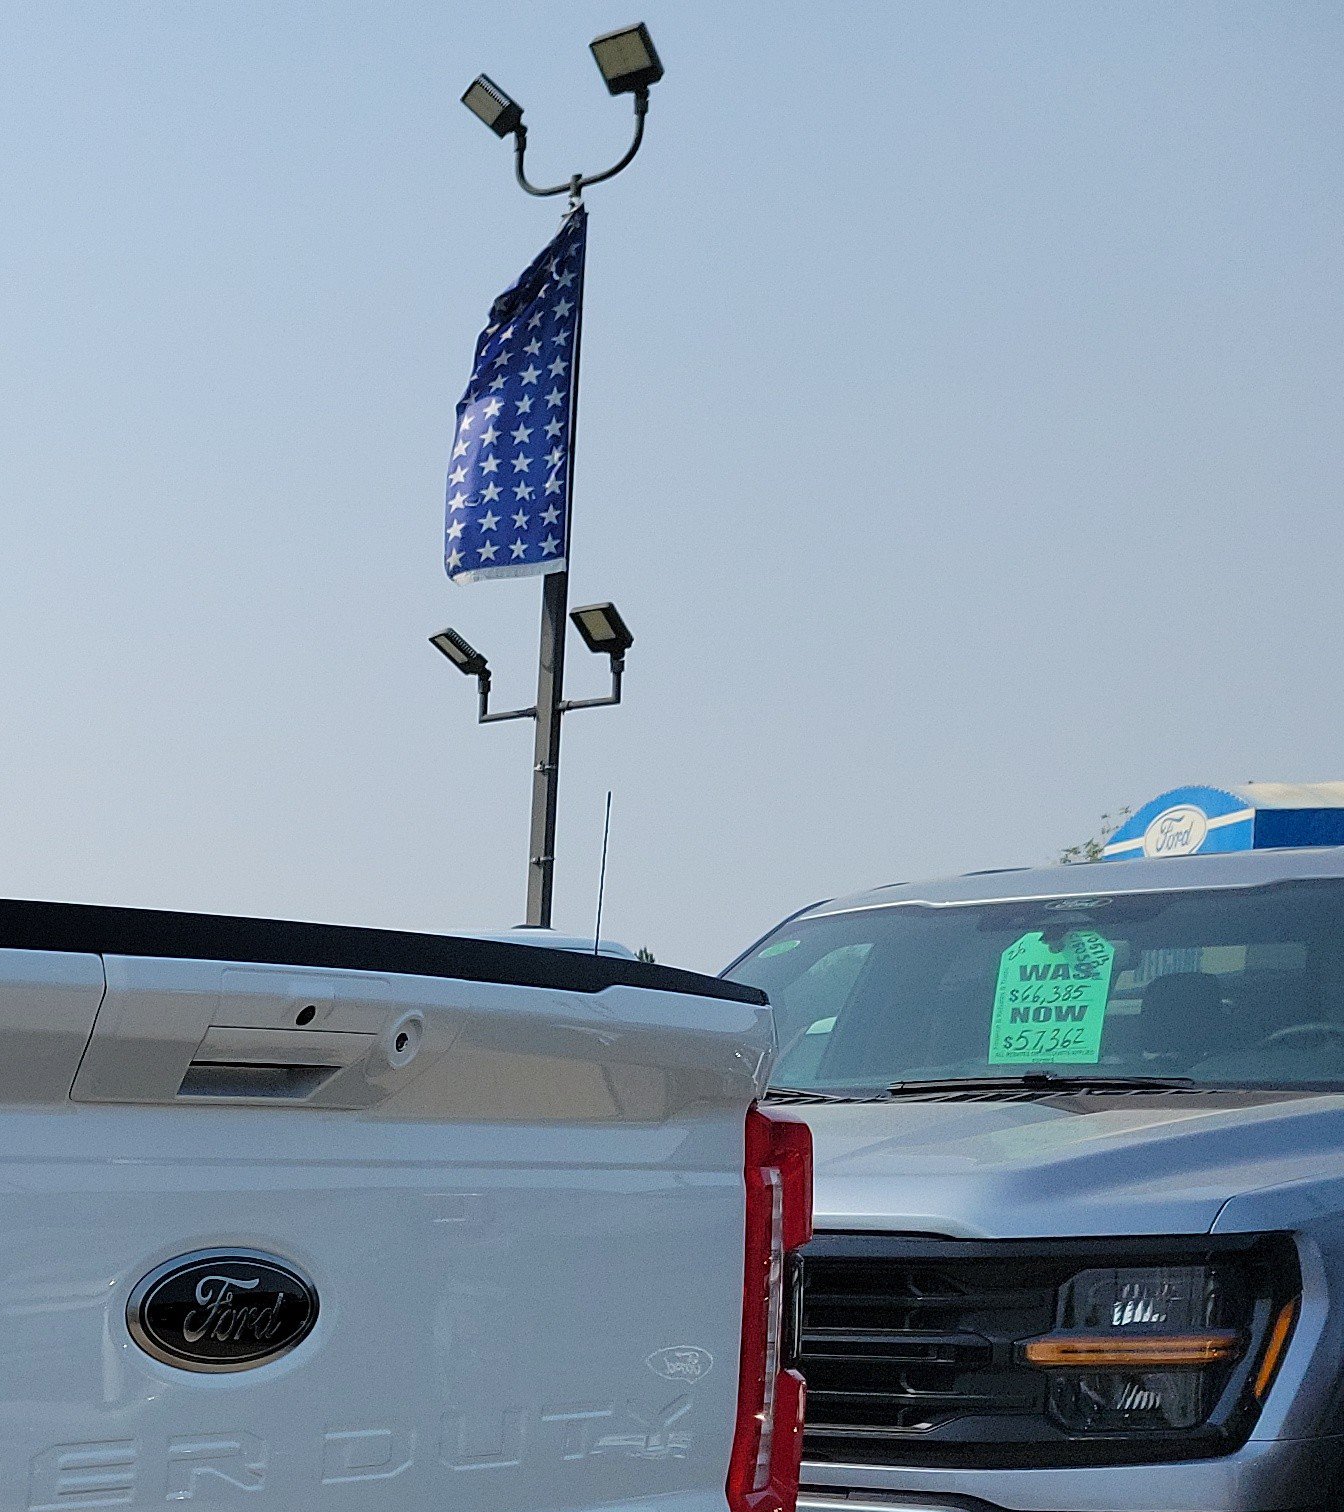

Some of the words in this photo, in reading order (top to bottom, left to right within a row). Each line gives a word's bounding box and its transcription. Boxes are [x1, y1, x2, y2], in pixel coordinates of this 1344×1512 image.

[1156, 814, 1194, 853] Ford
[1019, 963, 1092, 981] WAS
[1010, 1005, 1089, 1024] NOW
[183, 1275, 282, 1343] Ford
[321, 1393, 692, 1485] DUTY
